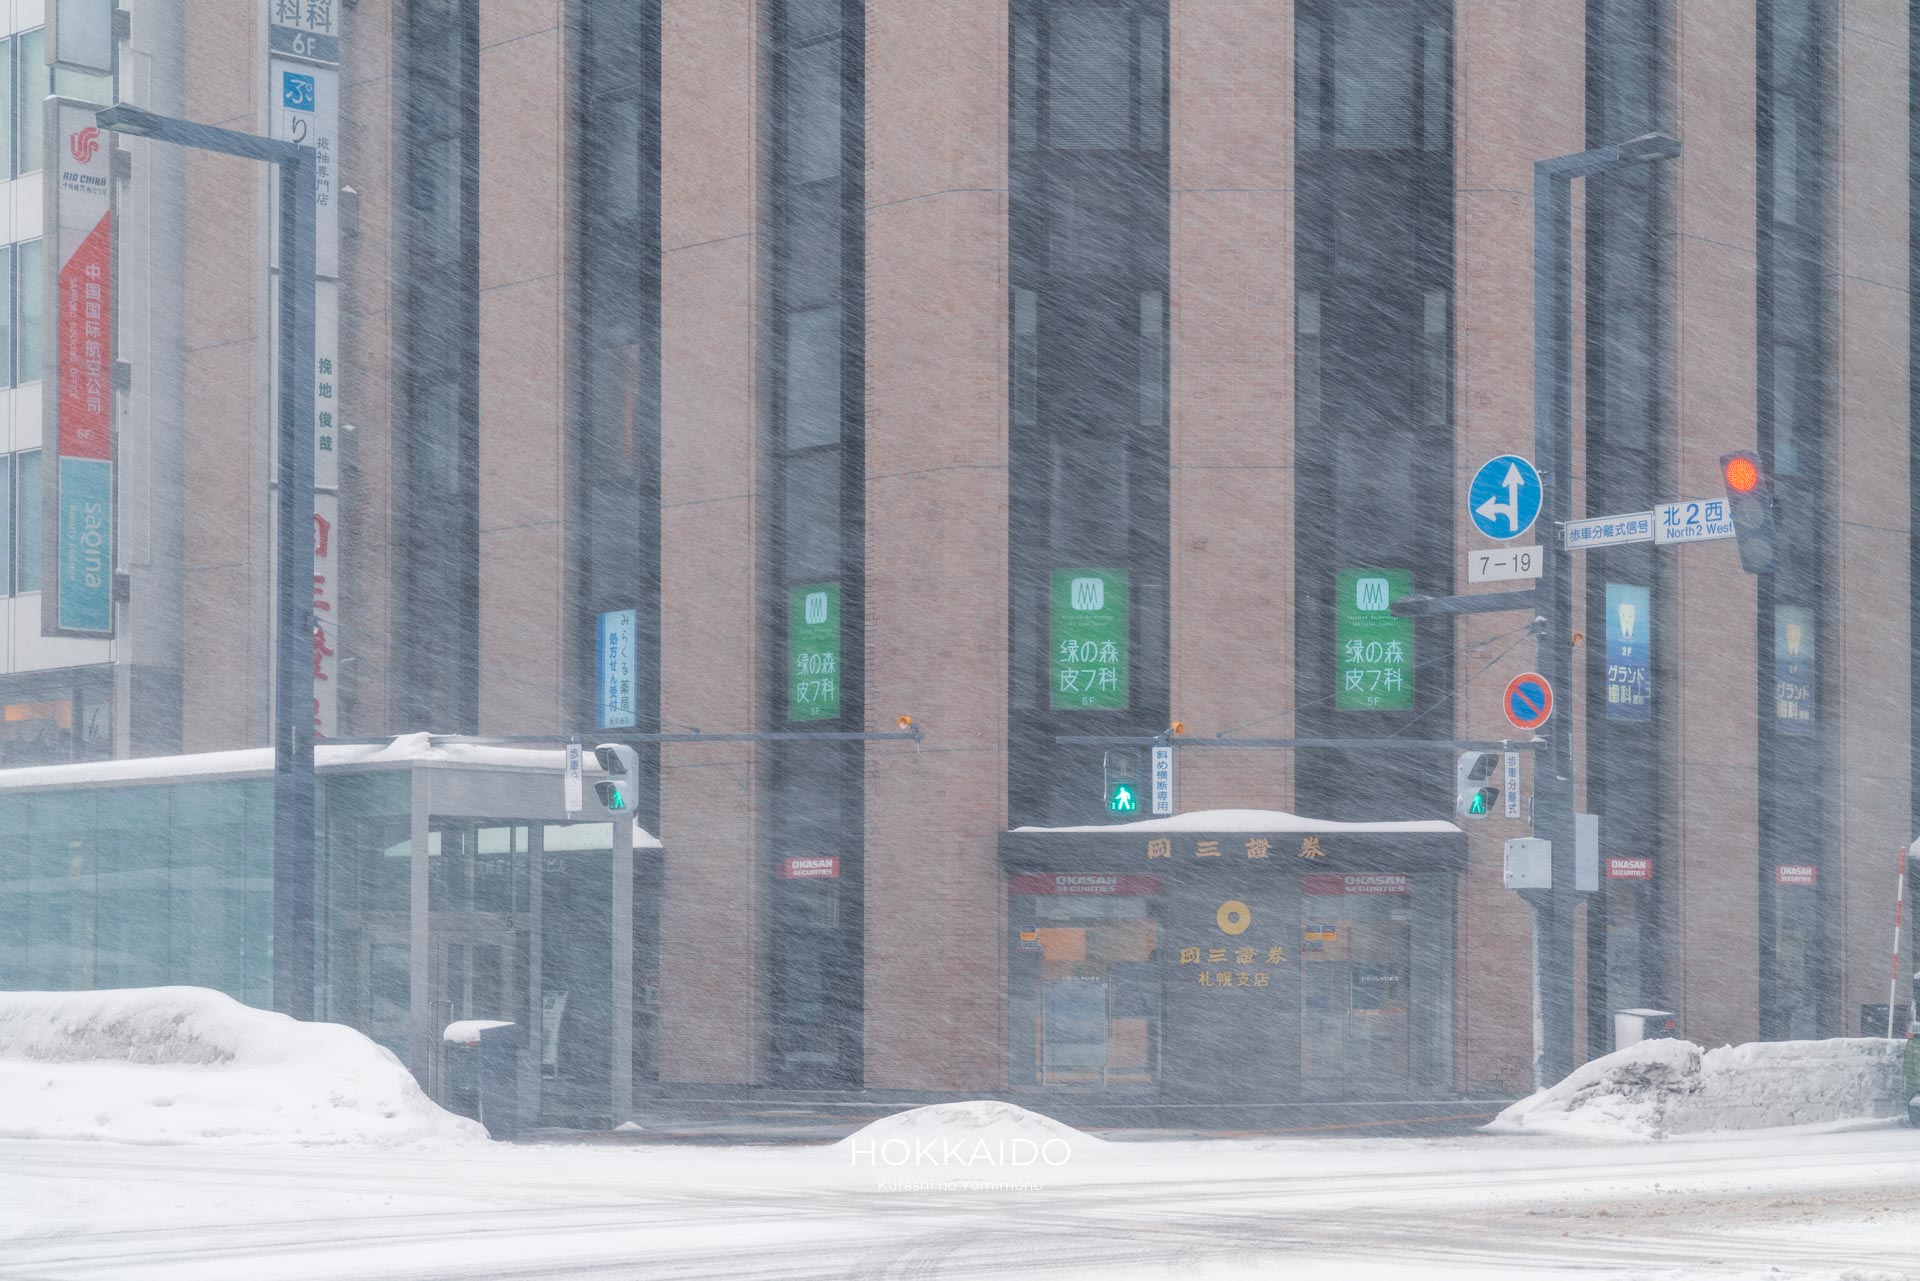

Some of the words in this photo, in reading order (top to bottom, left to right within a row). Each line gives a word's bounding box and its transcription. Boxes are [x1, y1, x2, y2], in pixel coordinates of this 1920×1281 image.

[293, 33, 316, 56] 6F
[63, 171, 79, 182] AIR
[80, 174, 107, 187] CHINA
[1569, 519, 1649, 542] 歩車分離式信号
[1666, 525, 1695, 539] North
[1706, 521, 1733, 535] West
[620, 614, 629, 711] みらくる薬局
[1060, 639, 1119, 663] 緑の森
[1345, 639, 1404, 664] 緑の森
[1622, 646, 1632, 656] 2F
[609, 632, 618, 712] 処方せん受付
[796, 651, 836, 676] 緑の森
[1608, 664, 1645, 684] グランド
[796, 678, 835, 704] 皮フ科
[1060, 667, 1118, 692] 皮フ科
[1345, 667, 1403, 692] 皮フ科
[1367, 696, 1381, 706] 5F
[1157, 750, 1168, 811] 斜め横断専用
[1508, 756, 1517, 814] 歩車分離式
[792, 859, 833, 869] OKASAN
[1611, 860, 1647, 869] OKASAN
[1780, 866, 1812, 876] OKASAN
[1055, 876, 1117, 885] OKASAN
[1344, 876, 1406, 885] OKASAN
[1199, 971, 1270, 987] 札幌支店
